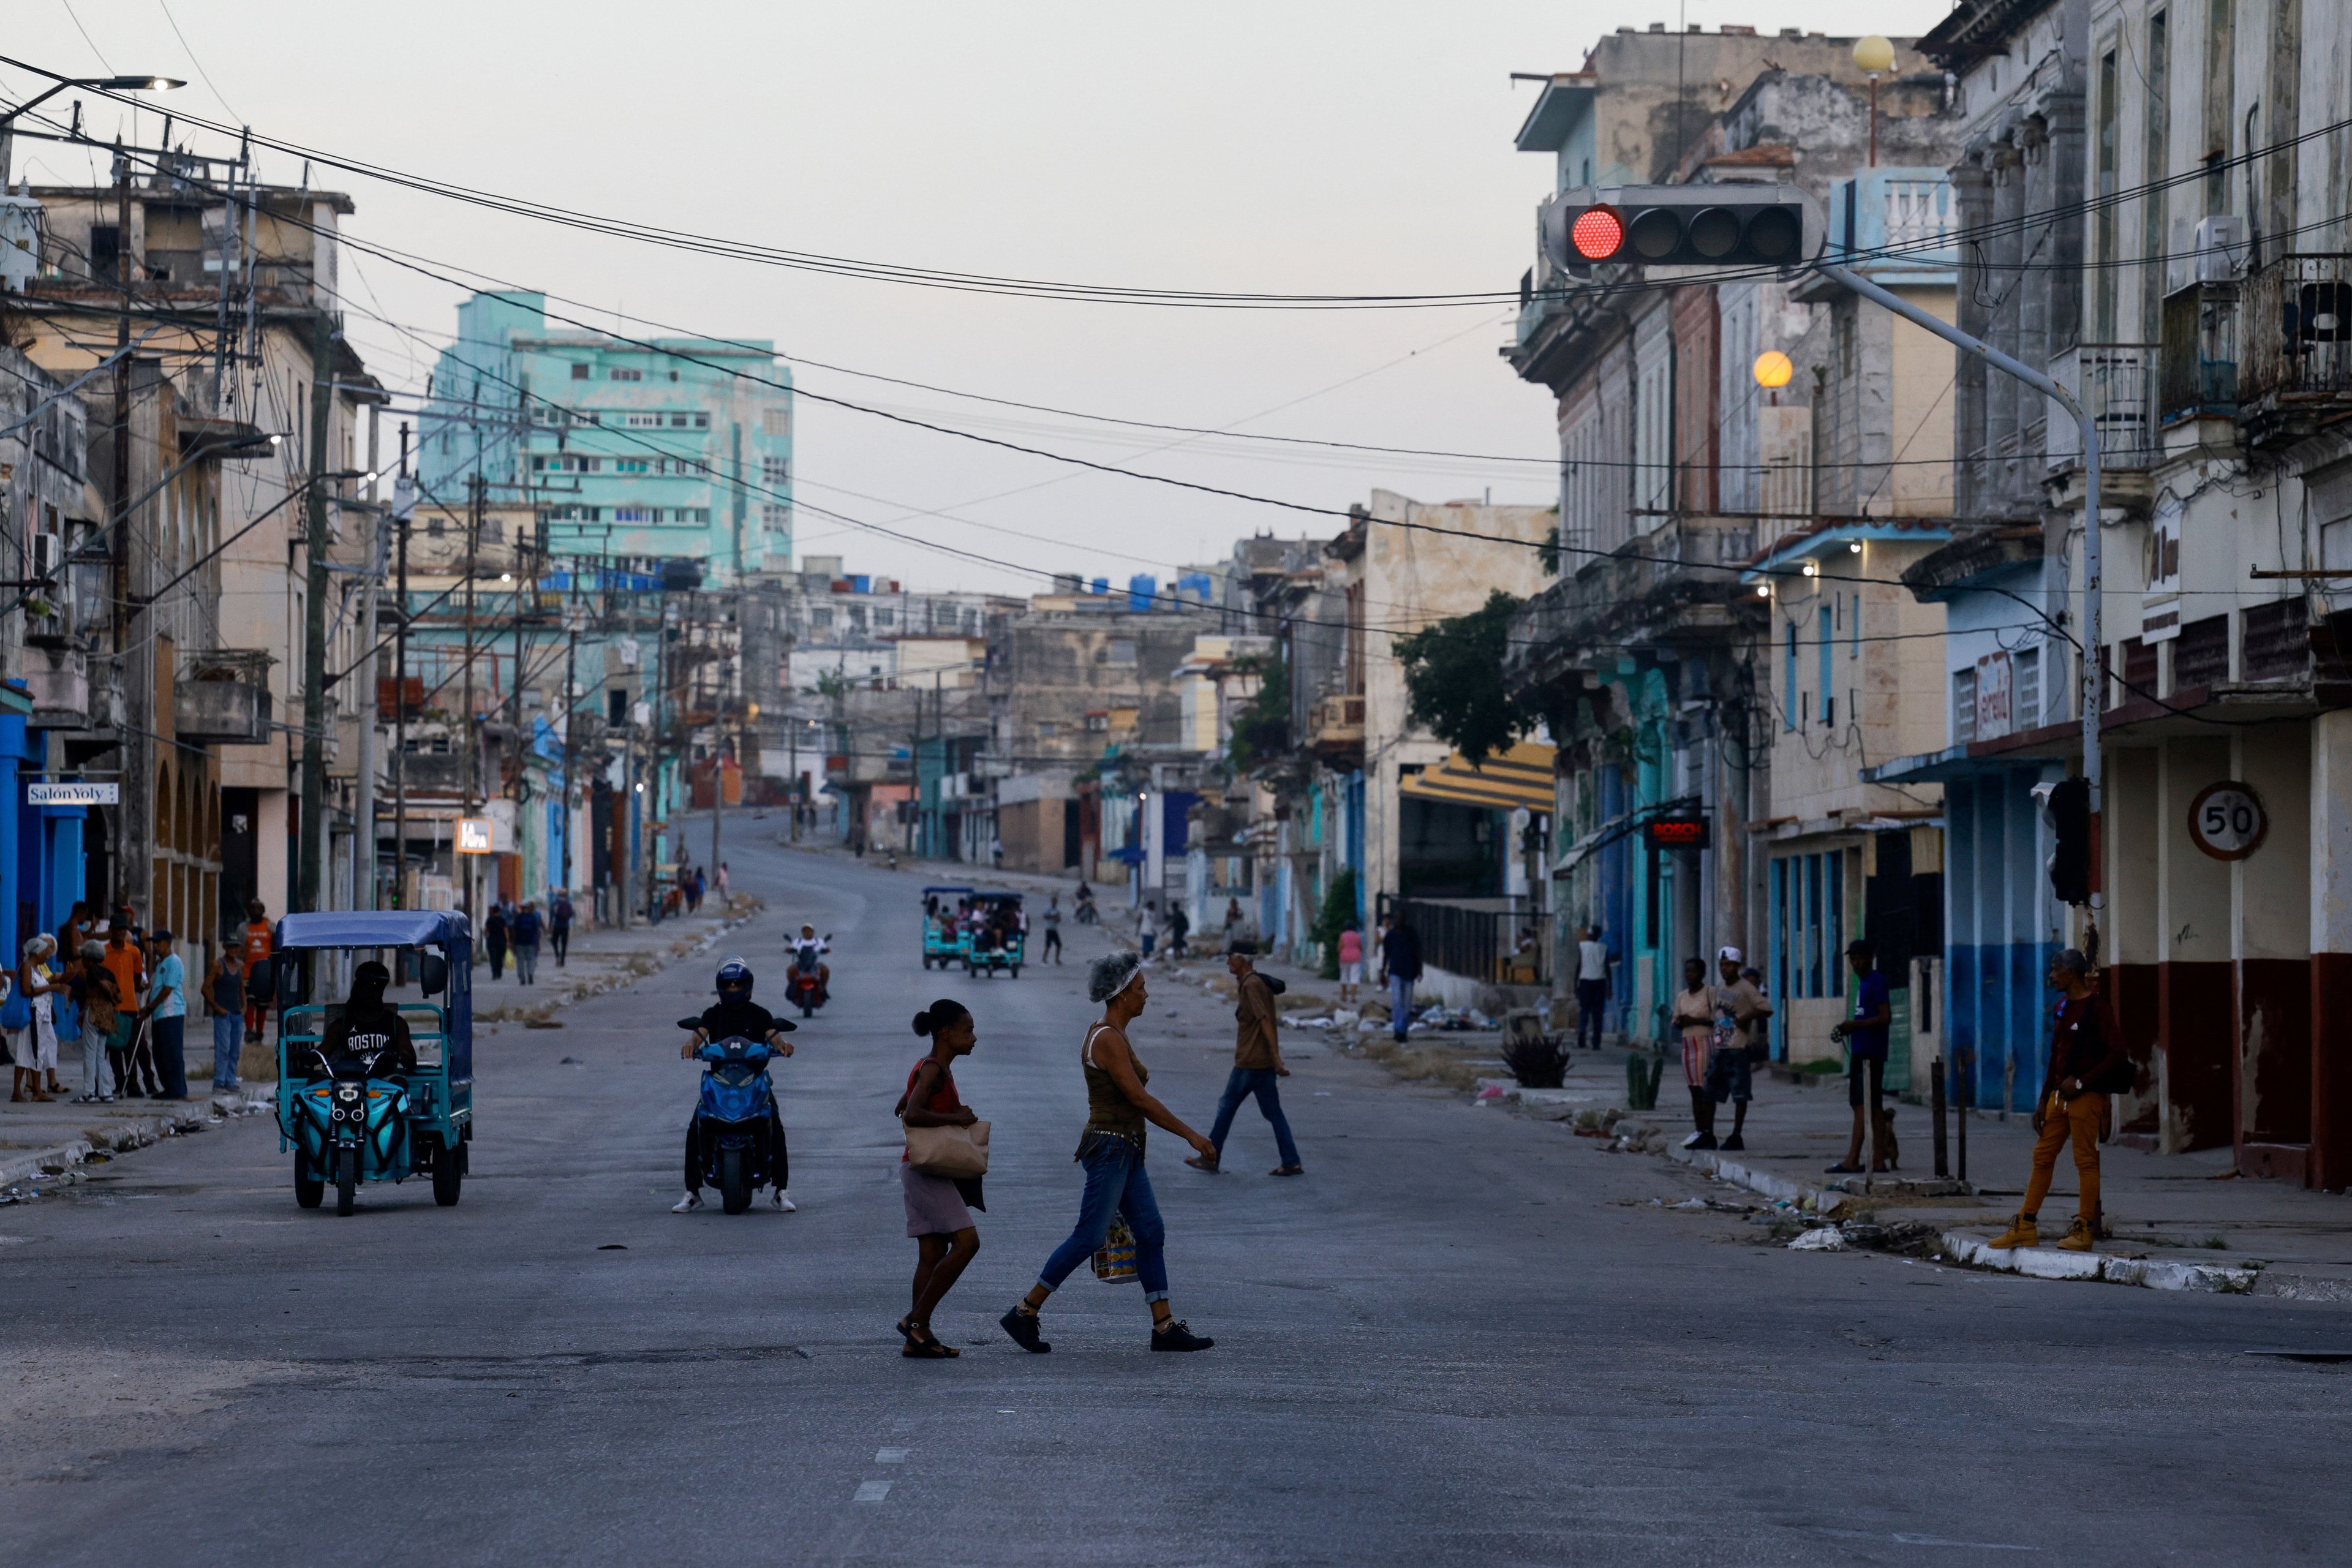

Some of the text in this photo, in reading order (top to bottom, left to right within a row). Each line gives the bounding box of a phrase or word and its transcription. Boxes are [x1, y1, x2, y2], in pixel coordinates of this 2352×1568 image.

[31, 787, 104, 801] Salón Yoly
[2206, 806, 2252, 834] 50
